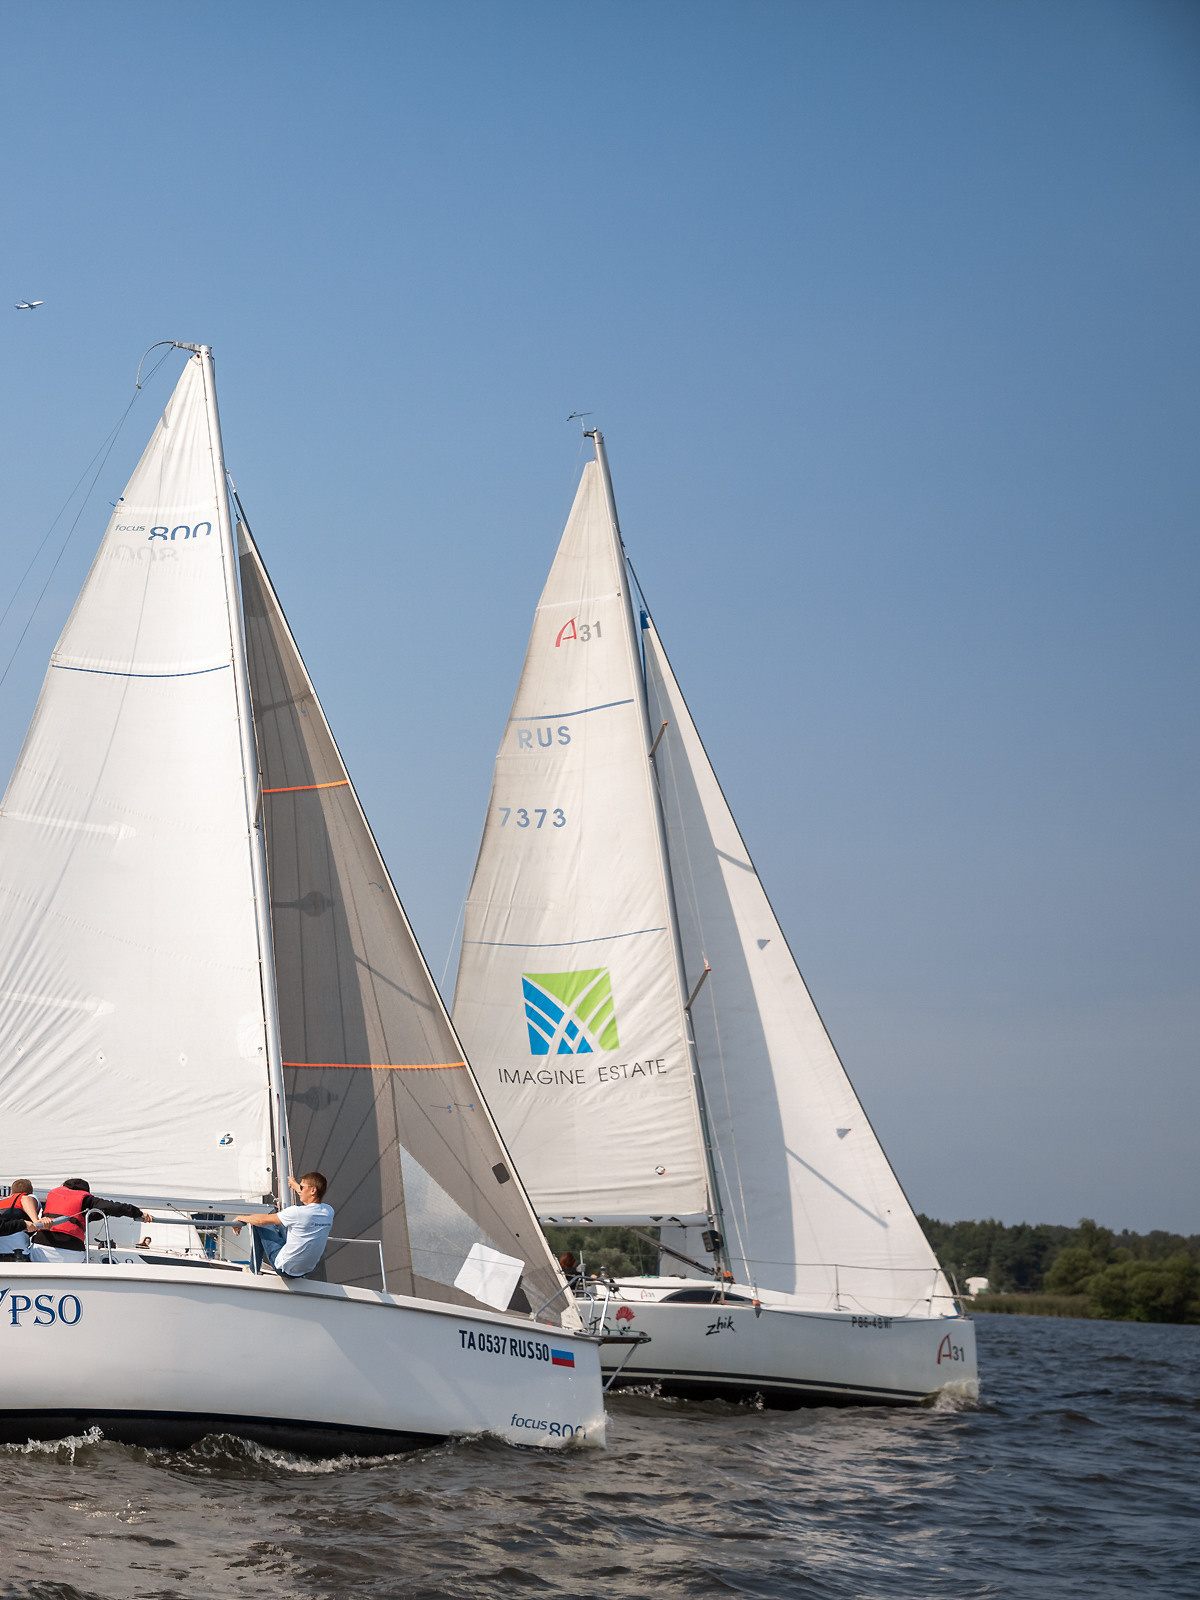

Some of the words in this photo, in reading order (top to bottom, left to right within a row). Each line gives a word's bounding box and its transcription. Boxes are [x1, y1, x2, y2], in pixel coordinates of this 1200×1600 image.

[517, 725, 572, 749] RUS
[498, 807, 567, 829] 7373
[498, 1068, 586, 1085] IMAGINE
[598, 1058, 668, 1083] ESTATE
[705, 1316, 736, 1336] zhik
[510, 1413, 548, 1431] focus
